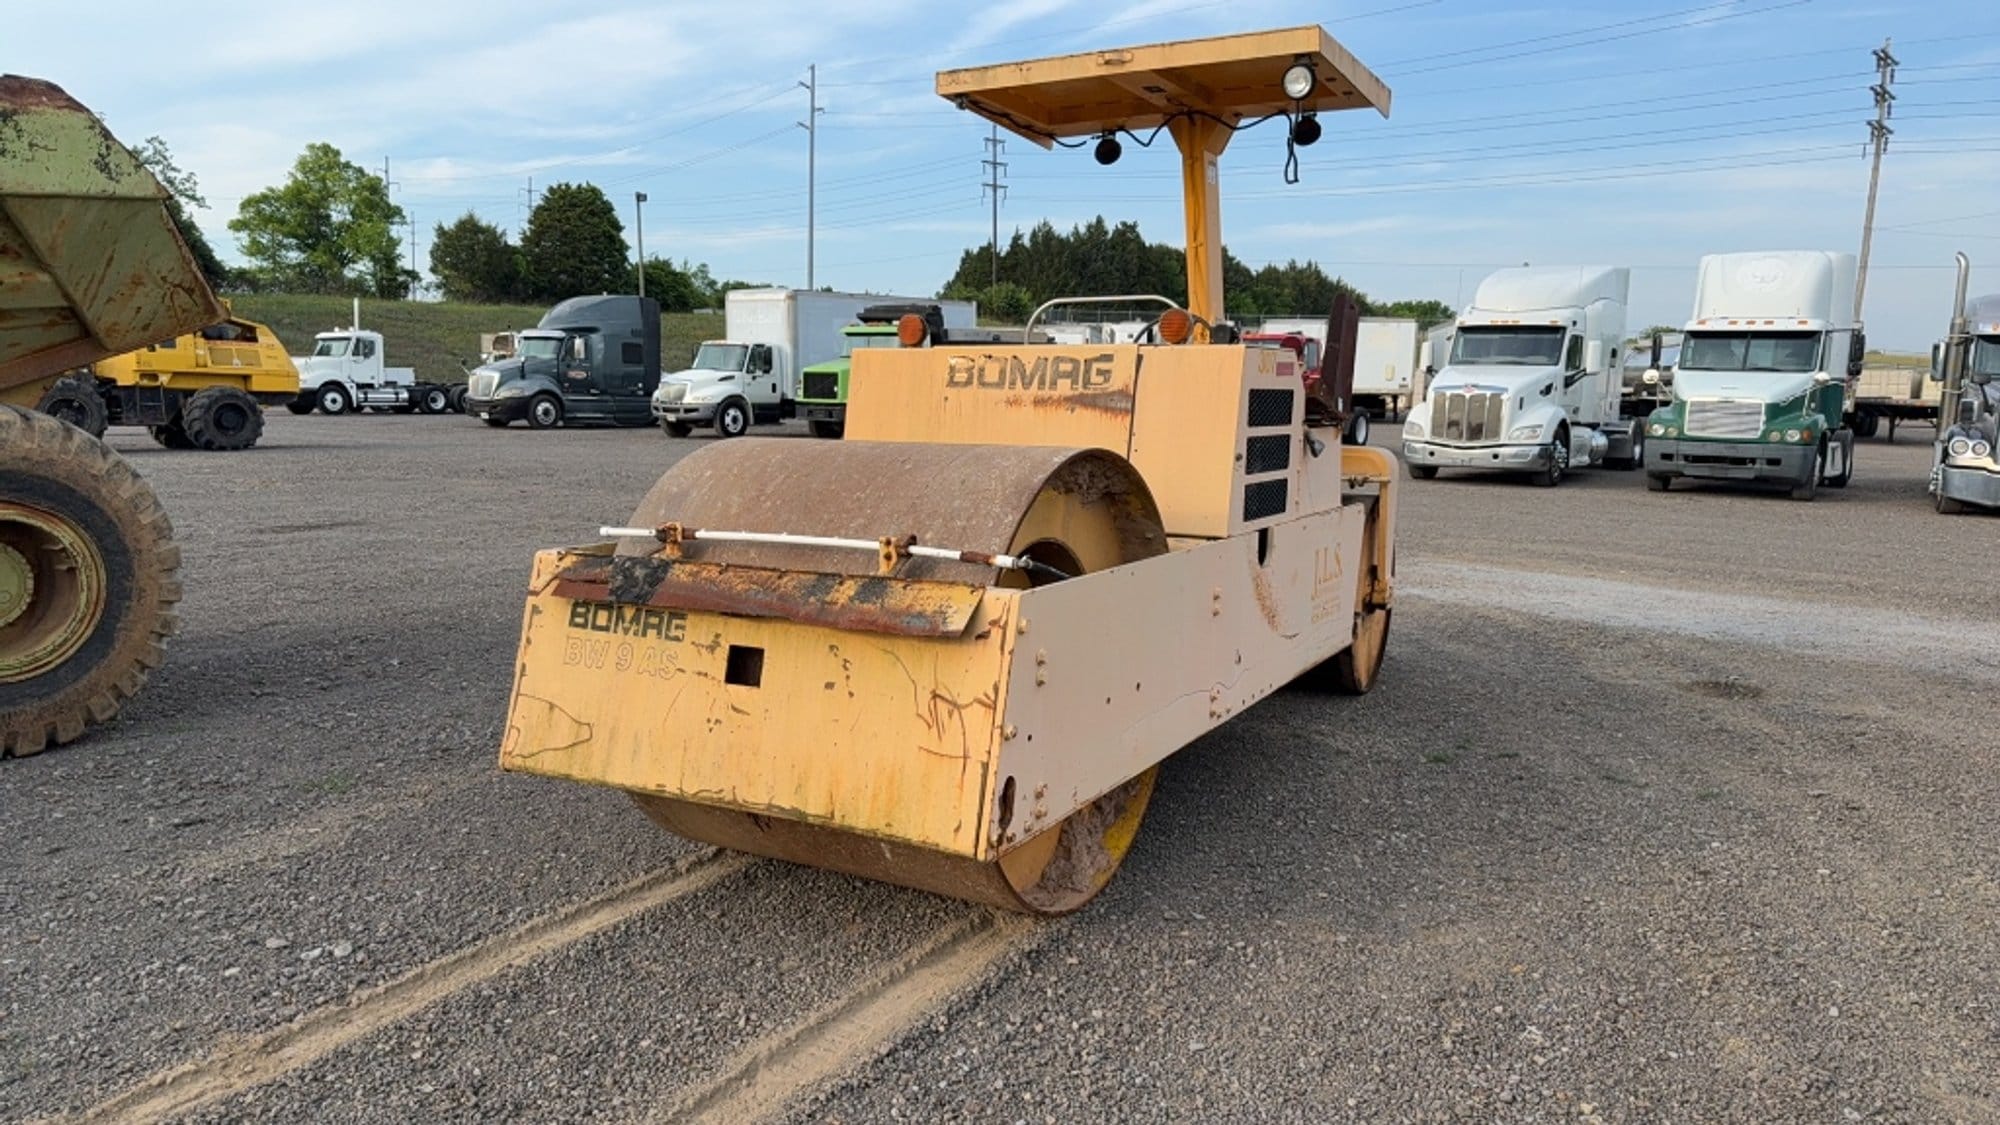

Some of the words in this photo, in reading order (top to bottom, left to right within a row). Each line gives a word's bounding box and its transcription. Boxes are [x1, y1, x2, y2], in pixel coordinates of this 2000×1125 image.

[946, 353, 1114, 391] BOMAG
[568, 599, 688, 642] BOMAG
[563, 636, 610, 669] BW
[615, 641, 634, 672] 9
[637, 645, 679, 681] AS
